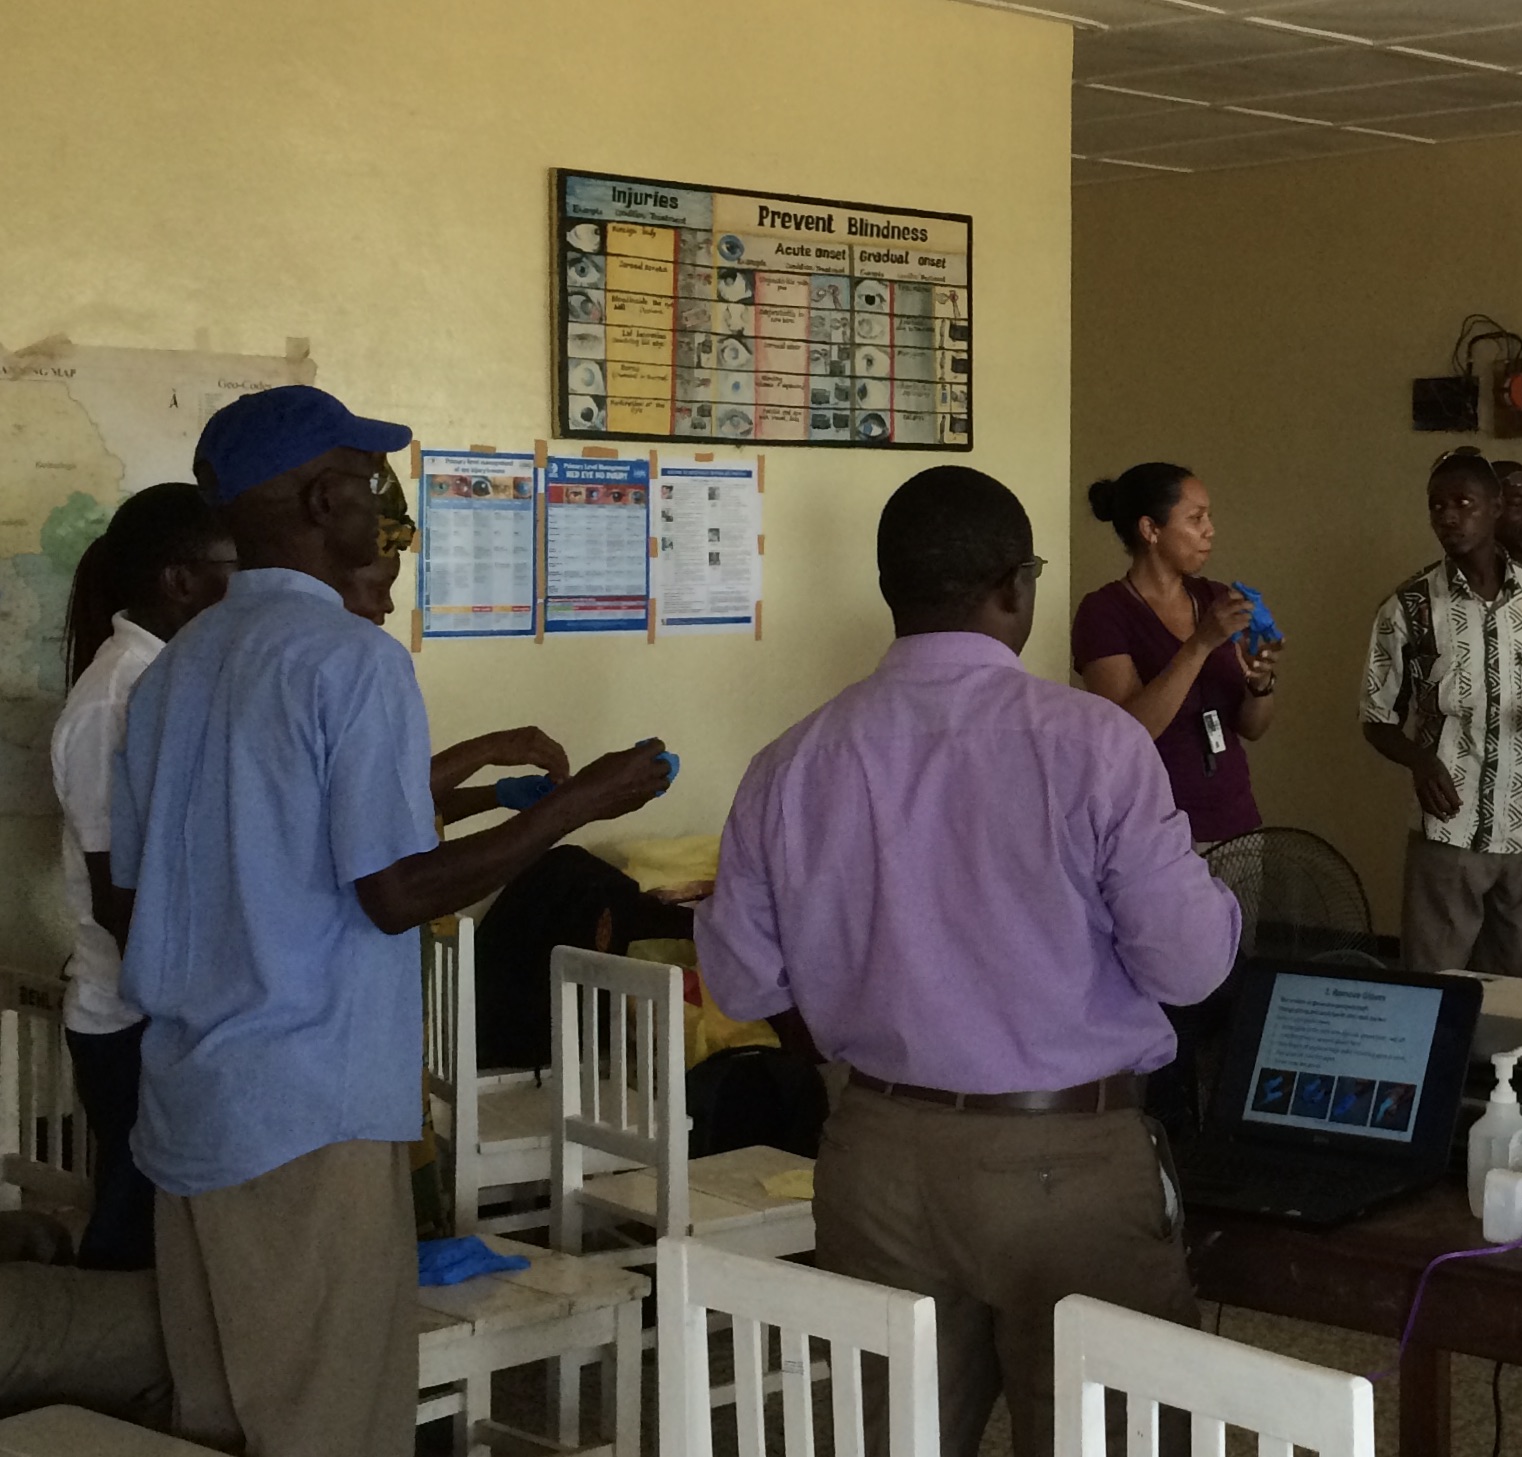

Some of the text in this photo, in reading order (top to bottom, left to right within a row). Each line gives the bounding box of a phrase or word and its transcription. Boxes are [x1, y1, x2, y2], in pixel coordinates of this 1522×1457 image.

[612, 186, 678, 209] Injuries
[758, 205, 928, 243] Prevent Blindness
[775, 242, 812, 257] Acute
[859, 249, 946, 269] Gradual onset
